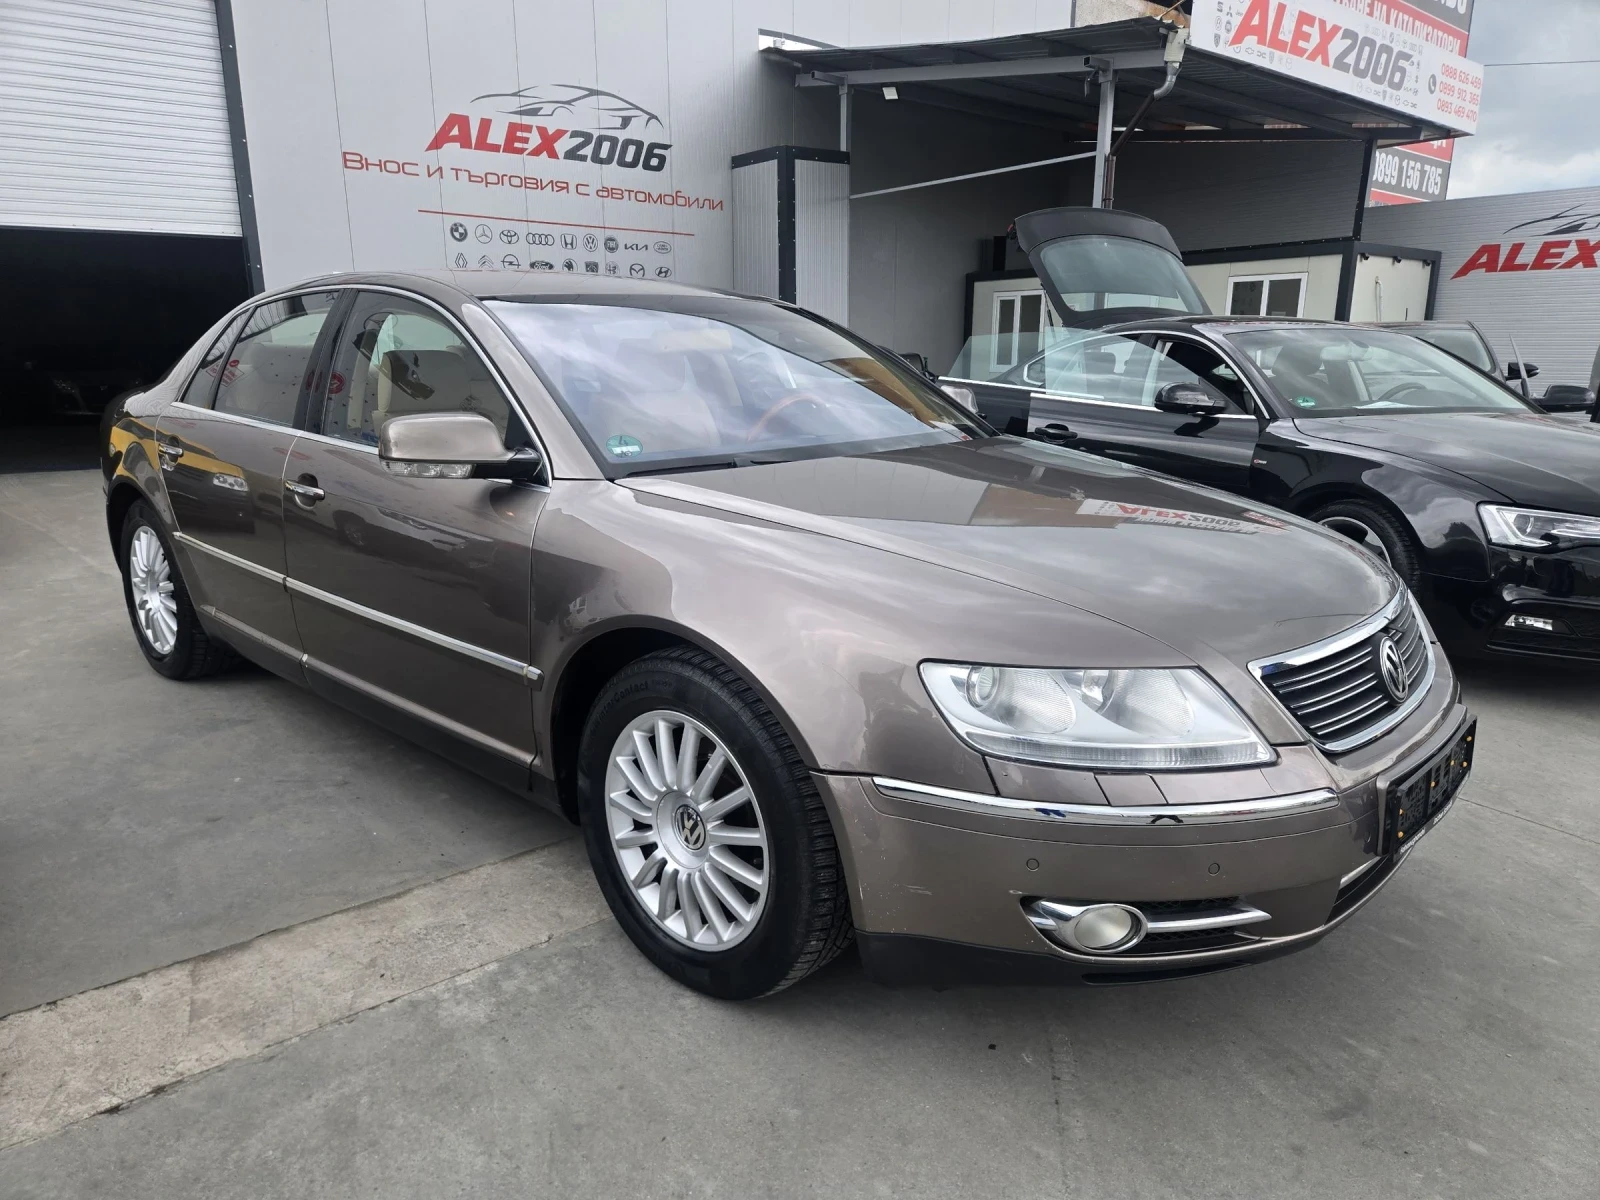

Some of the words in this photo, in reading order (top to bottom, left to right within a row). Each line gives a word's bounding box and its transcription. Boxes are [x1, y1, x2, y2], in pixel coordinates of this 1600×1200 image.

[1229, 0, 1414, 91] ALEX2006
[424, 112, 673, 172] ALEX2006
[342, 151, 419, 178] Внос
[426, 165, 443, 180] и
[450, 167, 569, 194] търговия
[596, 186, 723, 212] автомобили
[1401, 159, 1421, 191] 156
[1422, 164, 1443, 195] 785
